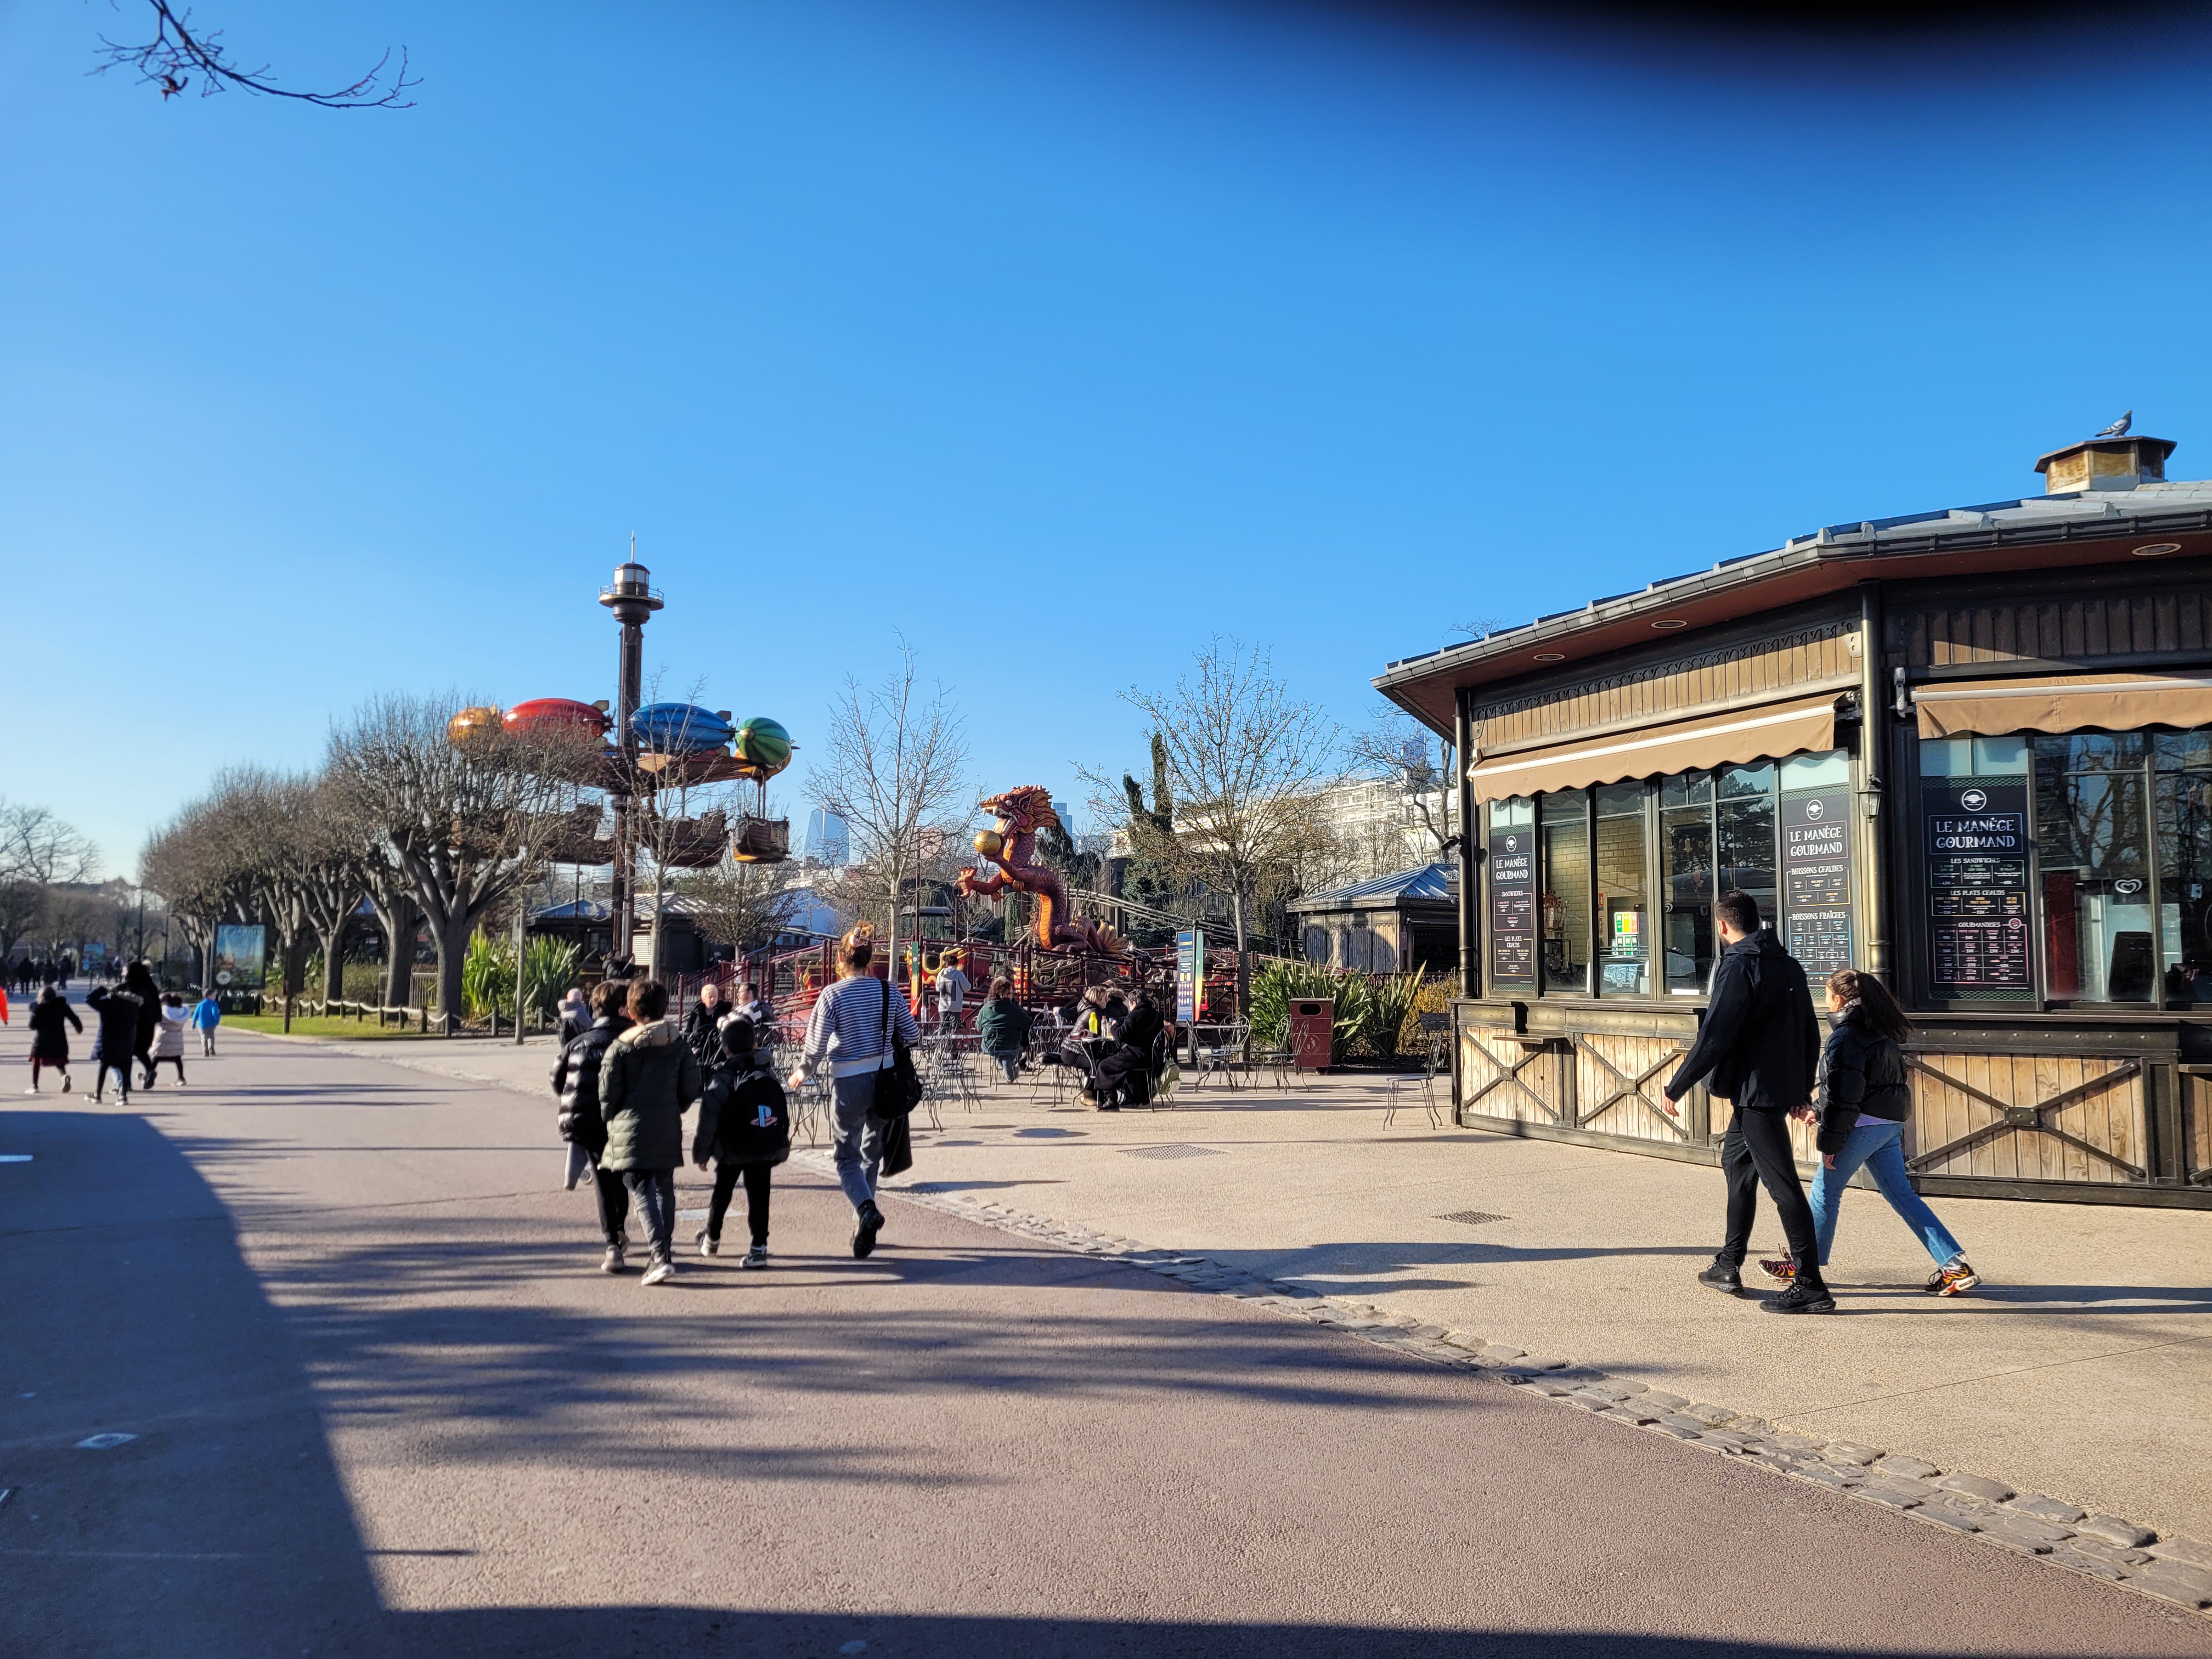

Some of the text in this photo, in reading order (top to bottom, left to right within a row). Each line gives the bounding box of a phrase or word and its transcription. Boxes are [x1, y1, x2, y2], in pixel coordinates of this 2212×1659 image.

[1936, 821, 1952, 832] LE
[1790, 831, 1801, 842] LE
[1936, 836, 2015, 848] GOURMAND
[1790, 842, 1843, 856] GOURMAND
[1496, 860, 1503, 868] LE
[1496, 869, 1528, 880] GOURMAND
[1791, 866, 1817, 875] BOISSONS
[1792, 912, 1818, 921] BOISSONS
